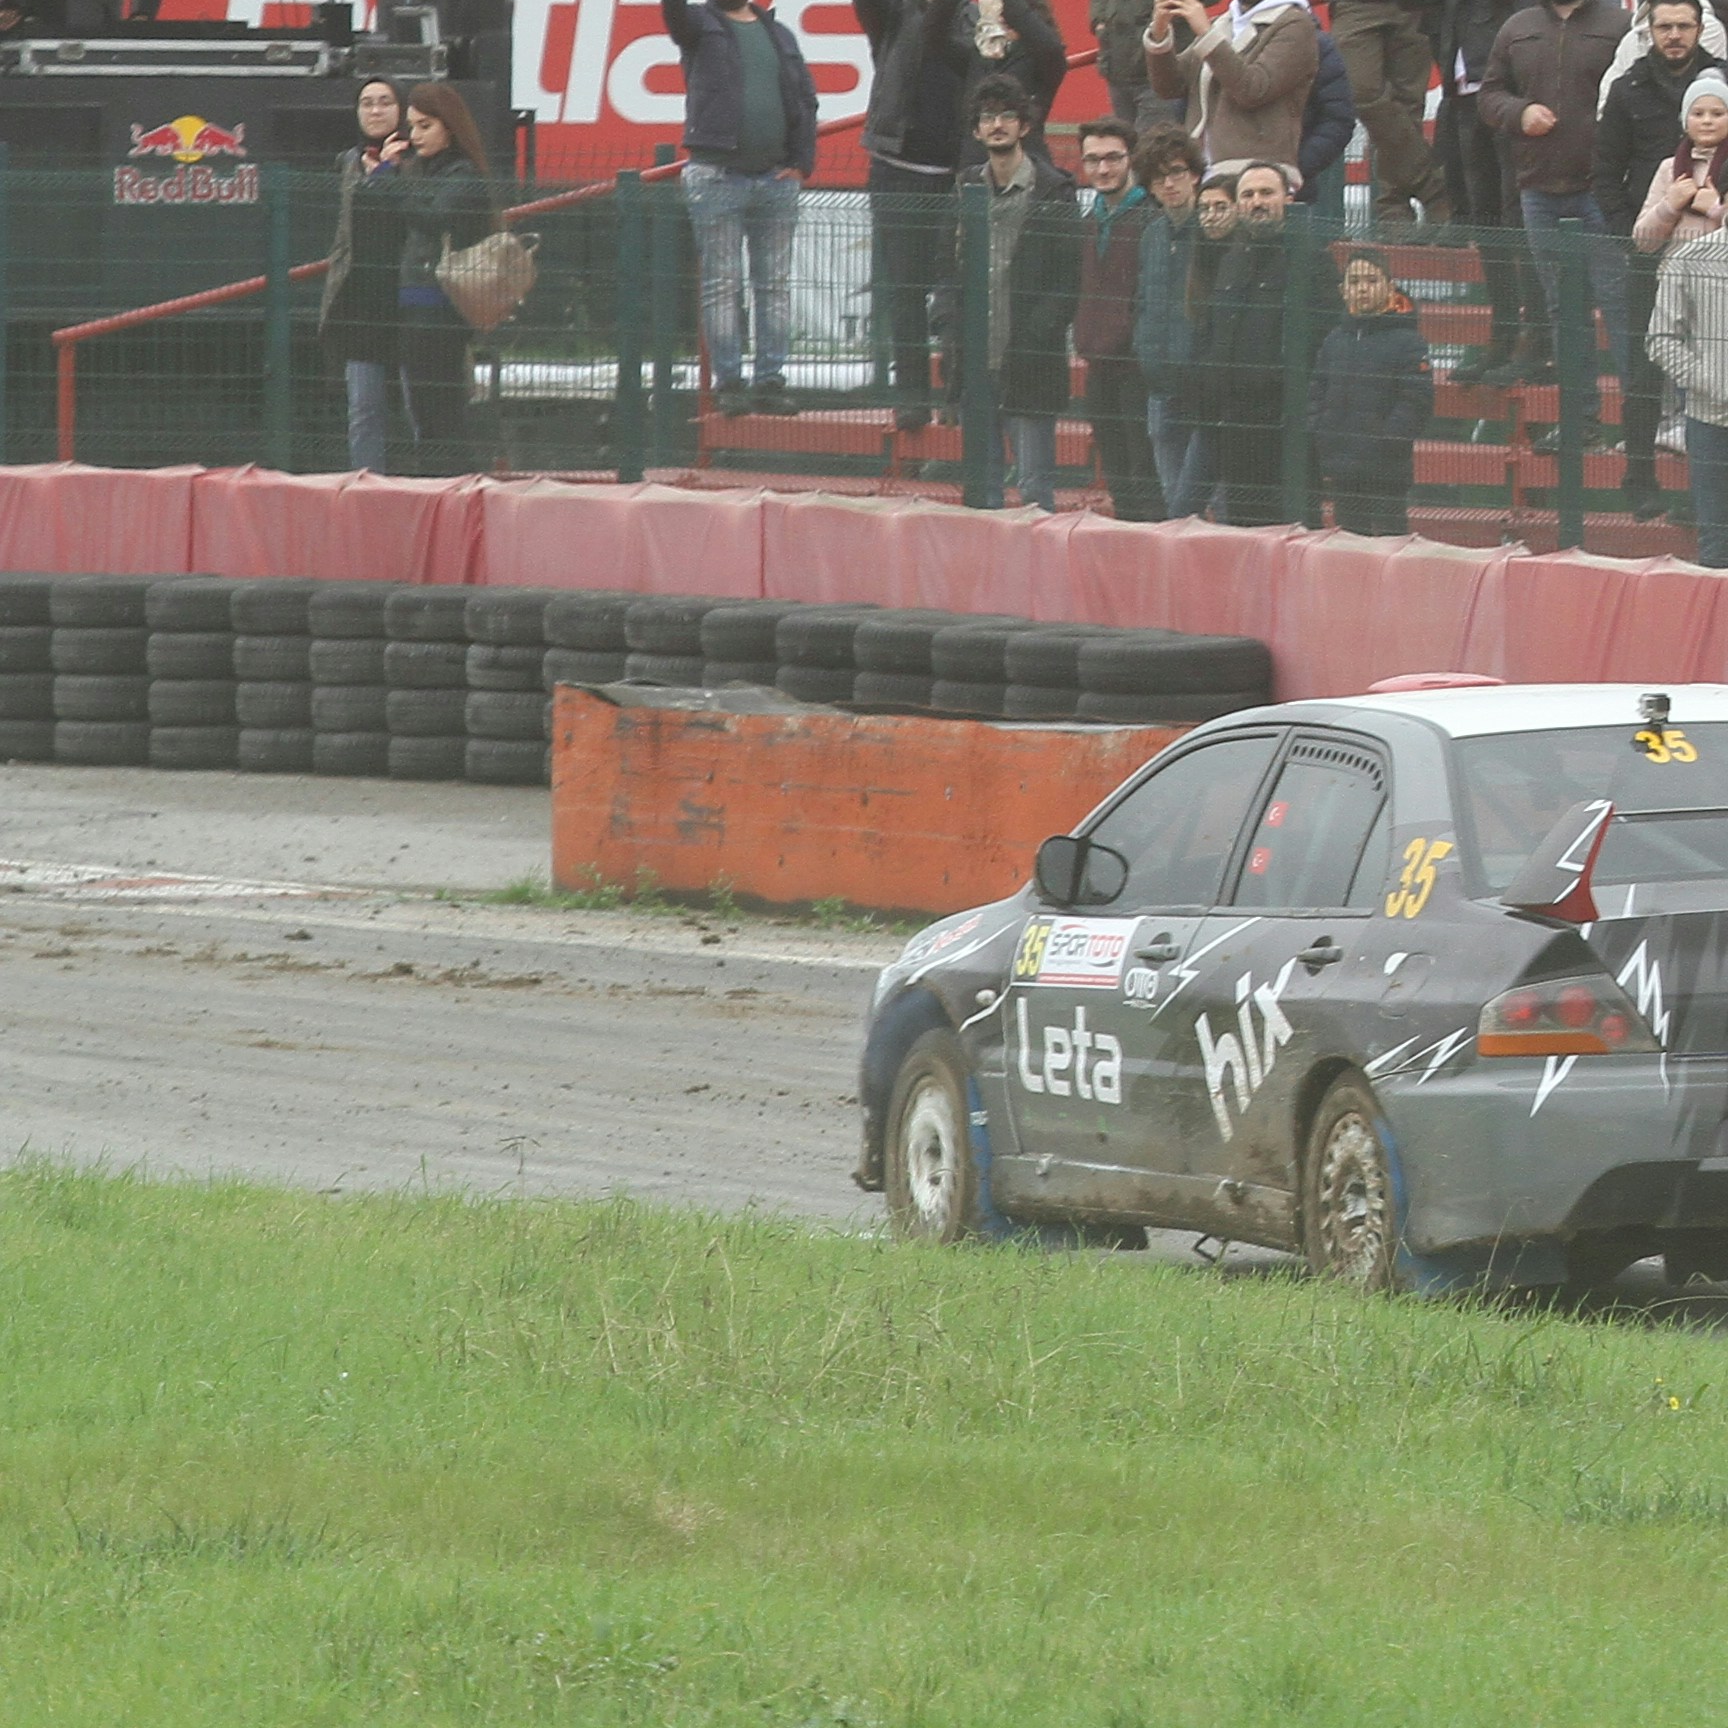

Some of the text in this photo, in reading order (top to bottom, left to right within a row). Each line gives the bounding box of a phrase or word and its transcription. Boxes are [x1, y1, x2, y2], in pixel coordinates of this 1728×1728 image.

[115, 163, 259, 204] Red Bull
[1634, 730, 1698, 763] 35
[1385, 837, 1454, 919] 35
[1016, 924, 1051, 976] 35
[1016, 997, 1123, 1105] Leta
